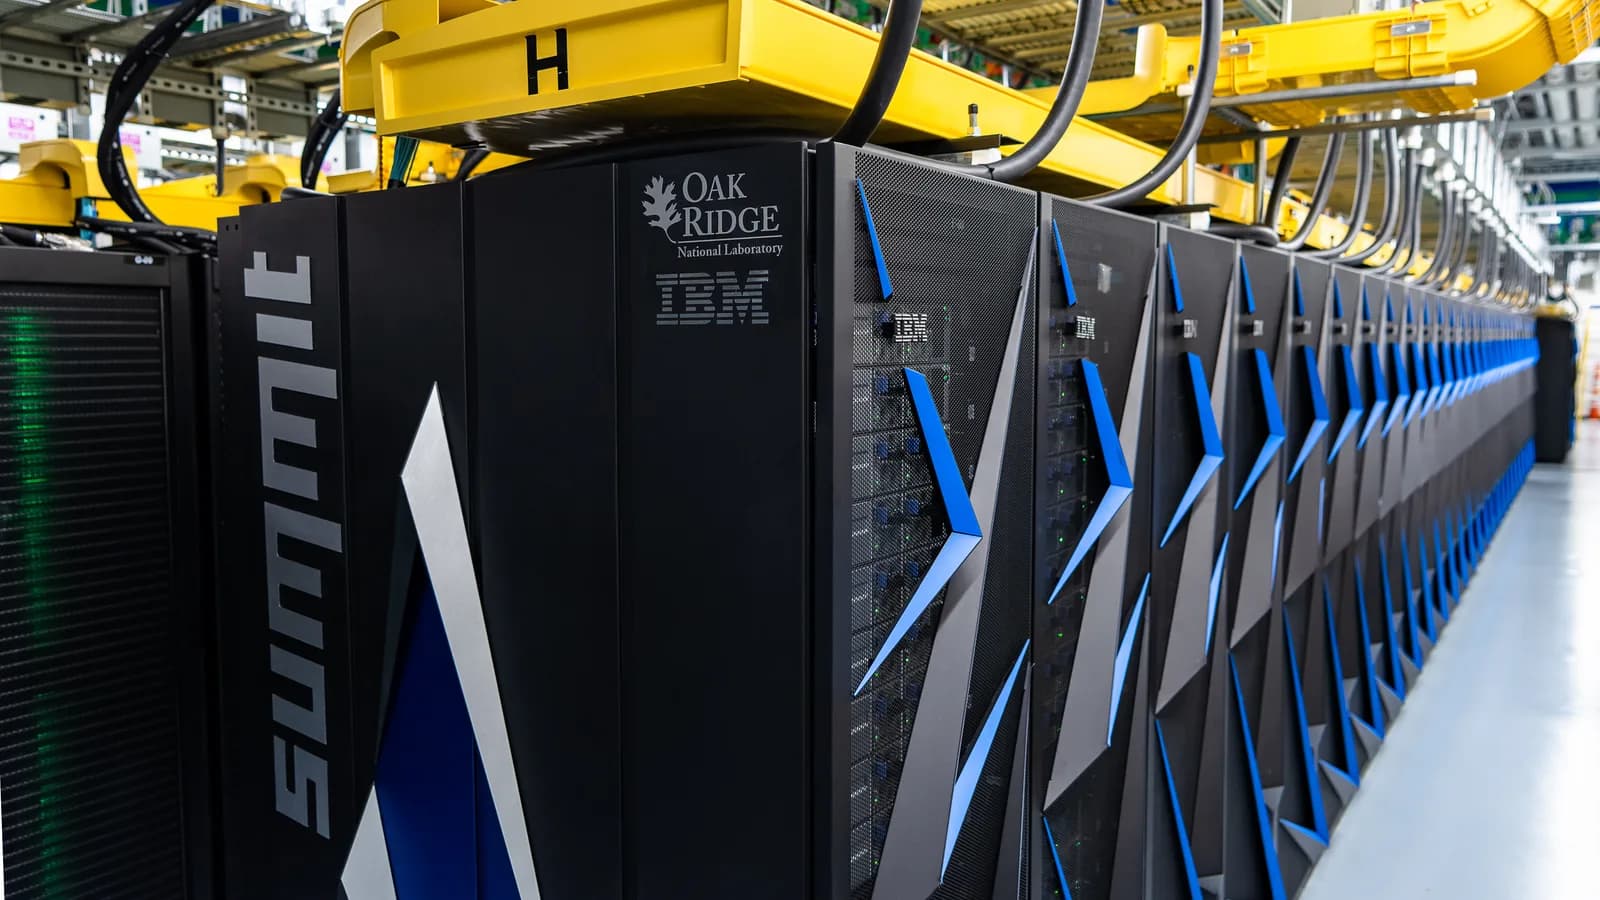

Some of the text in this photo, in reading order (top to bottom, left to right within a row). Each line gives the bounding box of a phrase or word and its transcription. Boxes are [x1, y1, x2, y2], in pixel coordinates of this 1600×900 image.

[525, 28, 569, 95] H
[682, 171, 748, 203] OAK
[682, 205, 780, 237] RIDGE
[677, 243, 783, 258] National Laboratory
[656, 269, 769, 325] IBM
[895, 313, 928, 342] IBM
[1076, 315, 1096, 340] IBM
[243, 251, 342, 839] summit
